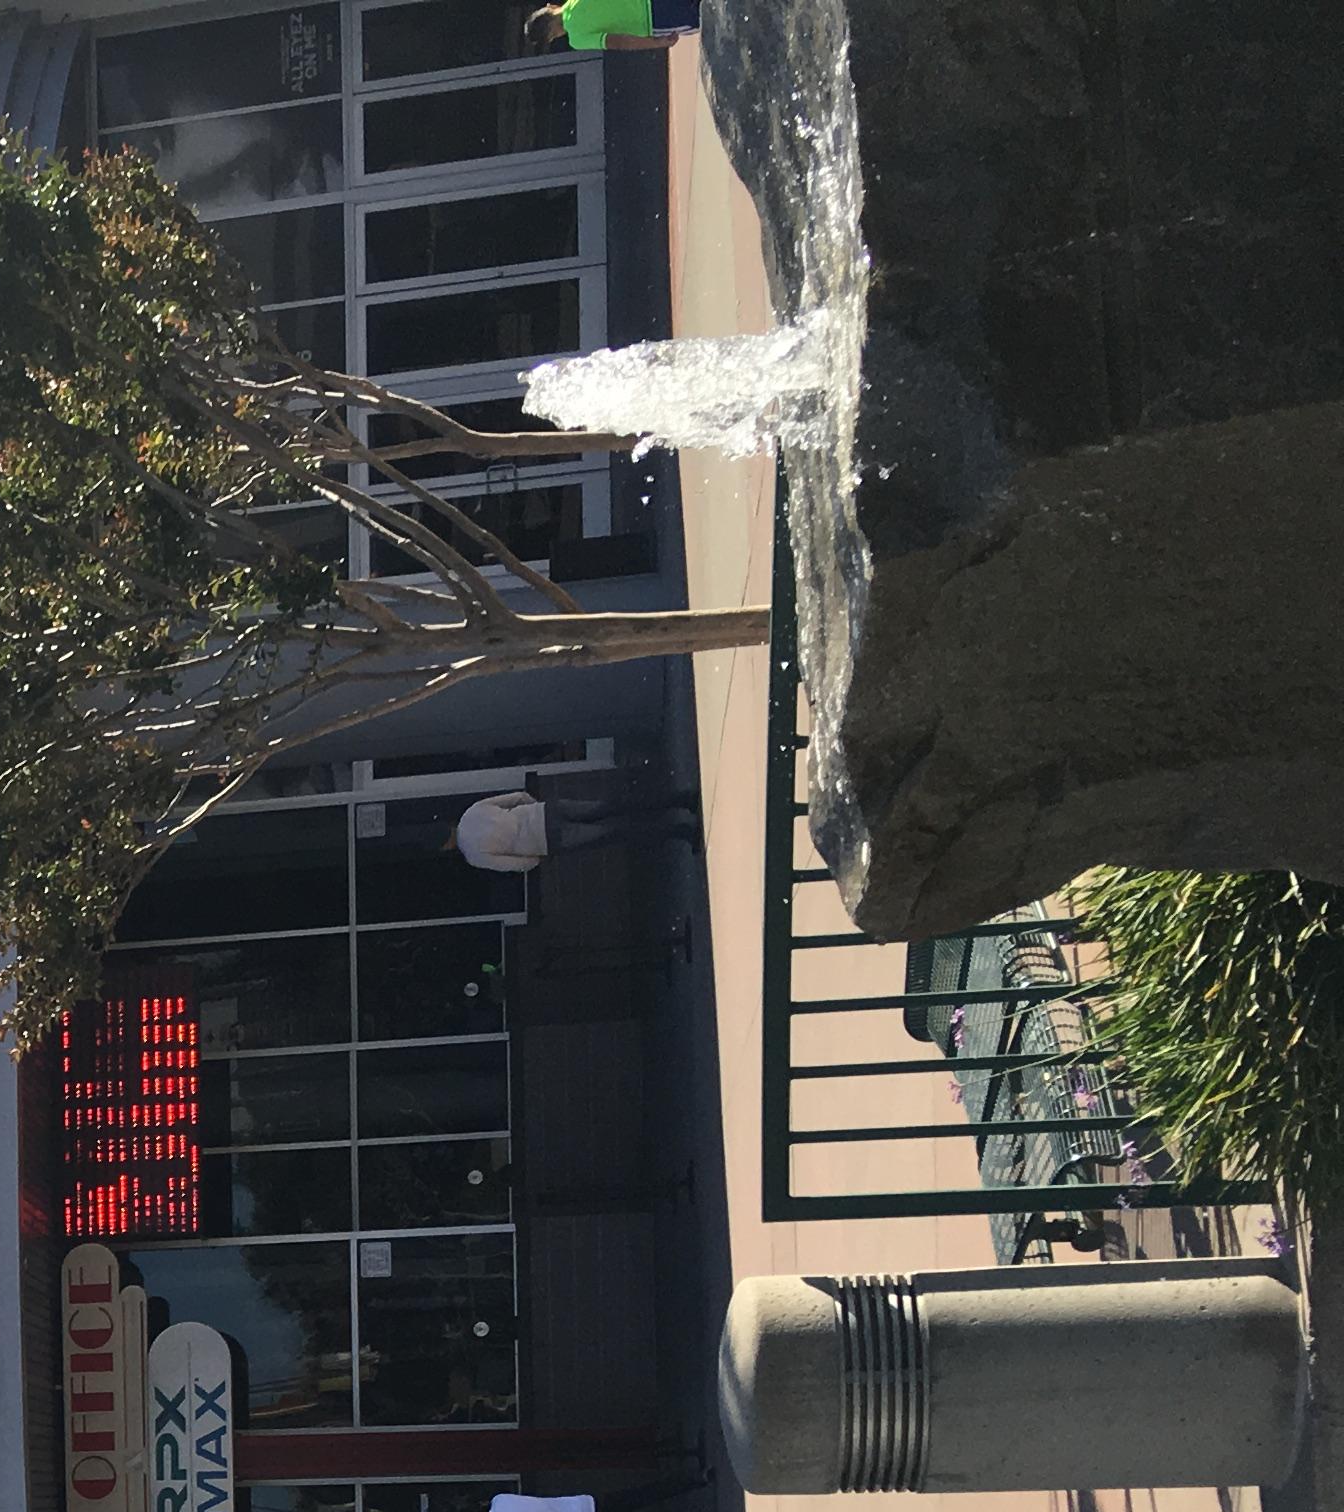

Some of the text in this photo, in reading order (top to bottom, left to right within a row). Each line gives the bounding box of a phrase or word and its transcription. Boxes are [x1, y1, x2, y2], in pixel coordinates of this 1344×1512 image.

[289, 12, 304, 93] ALL EYEZ
[304, 23, 318, 79] ON ME
[68, 1265, 117, 1500] OFFICE
